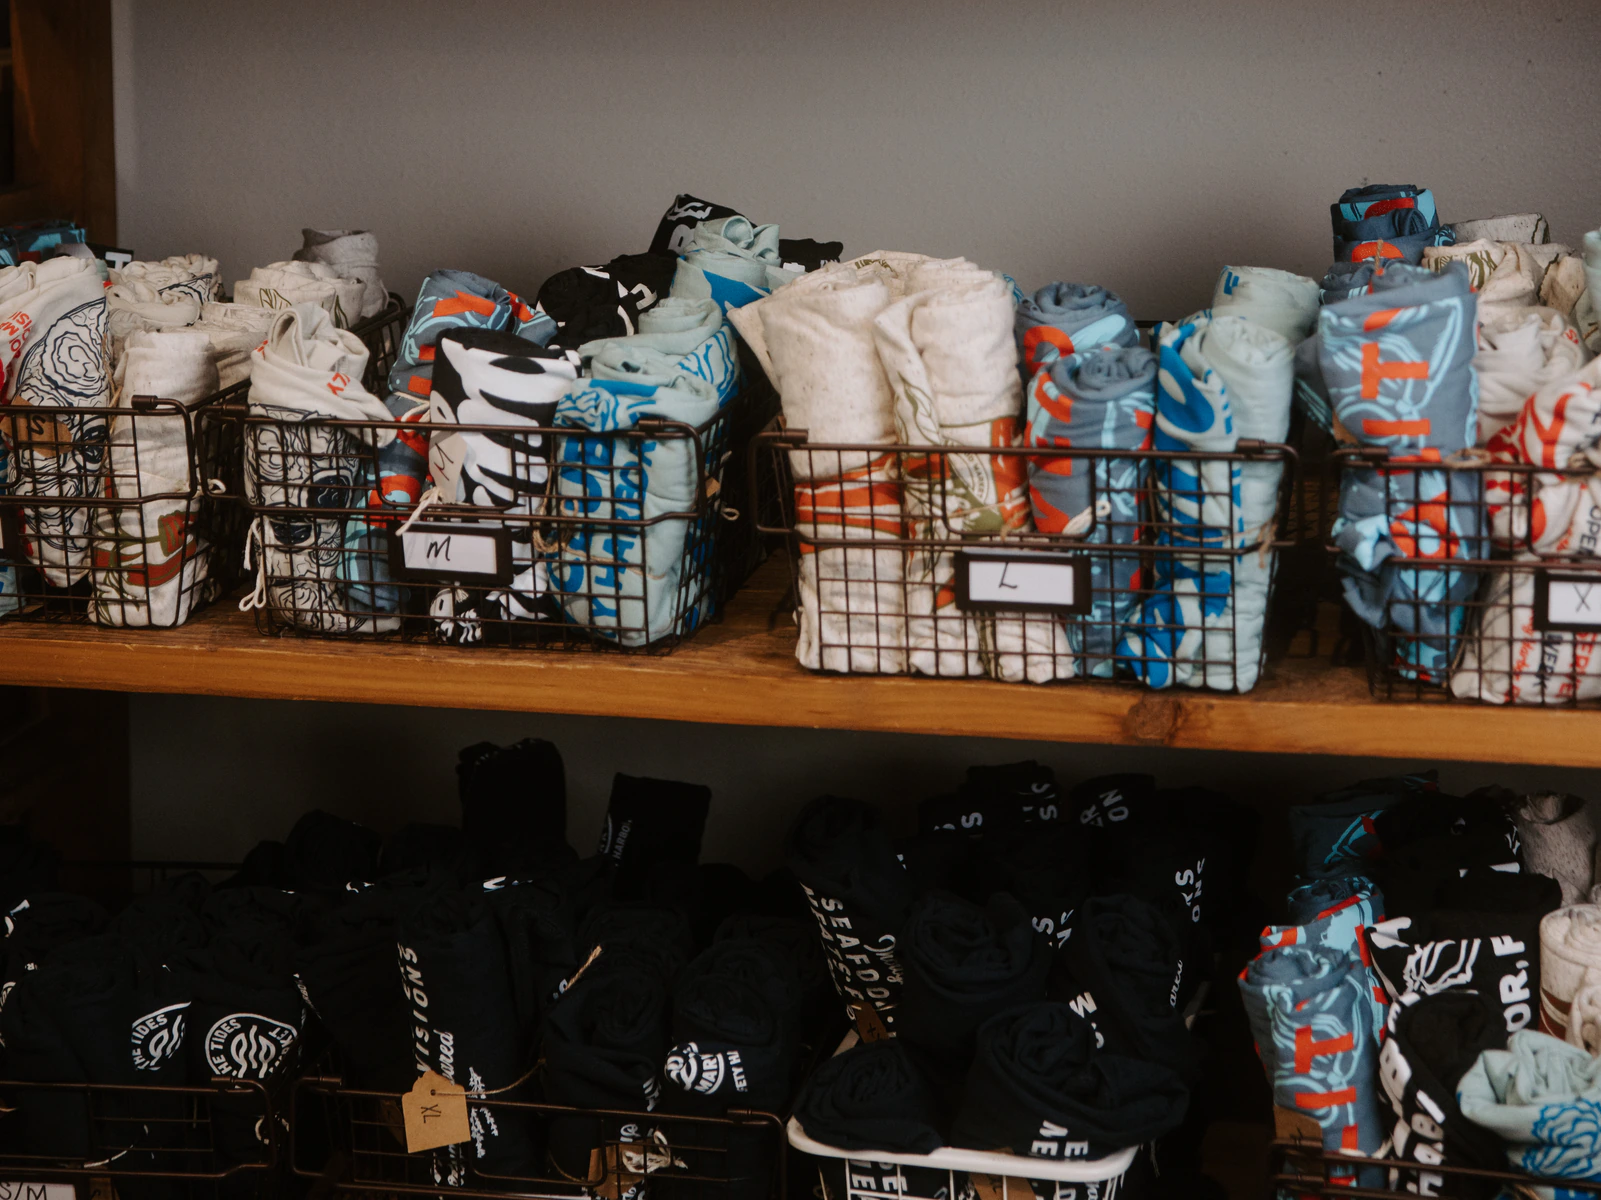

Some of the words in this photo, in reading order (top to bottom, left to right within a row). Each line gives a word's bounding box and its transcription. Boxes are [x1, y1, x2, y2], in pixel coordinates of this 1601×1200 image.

[426, 535, 451, 562] M
[999, 561, 1018, 589] L
[211, 1018, 242, 1050] TIDES
[211, 1054, 238, 1077] HE
[420, 1103, 442, 1124] XL
